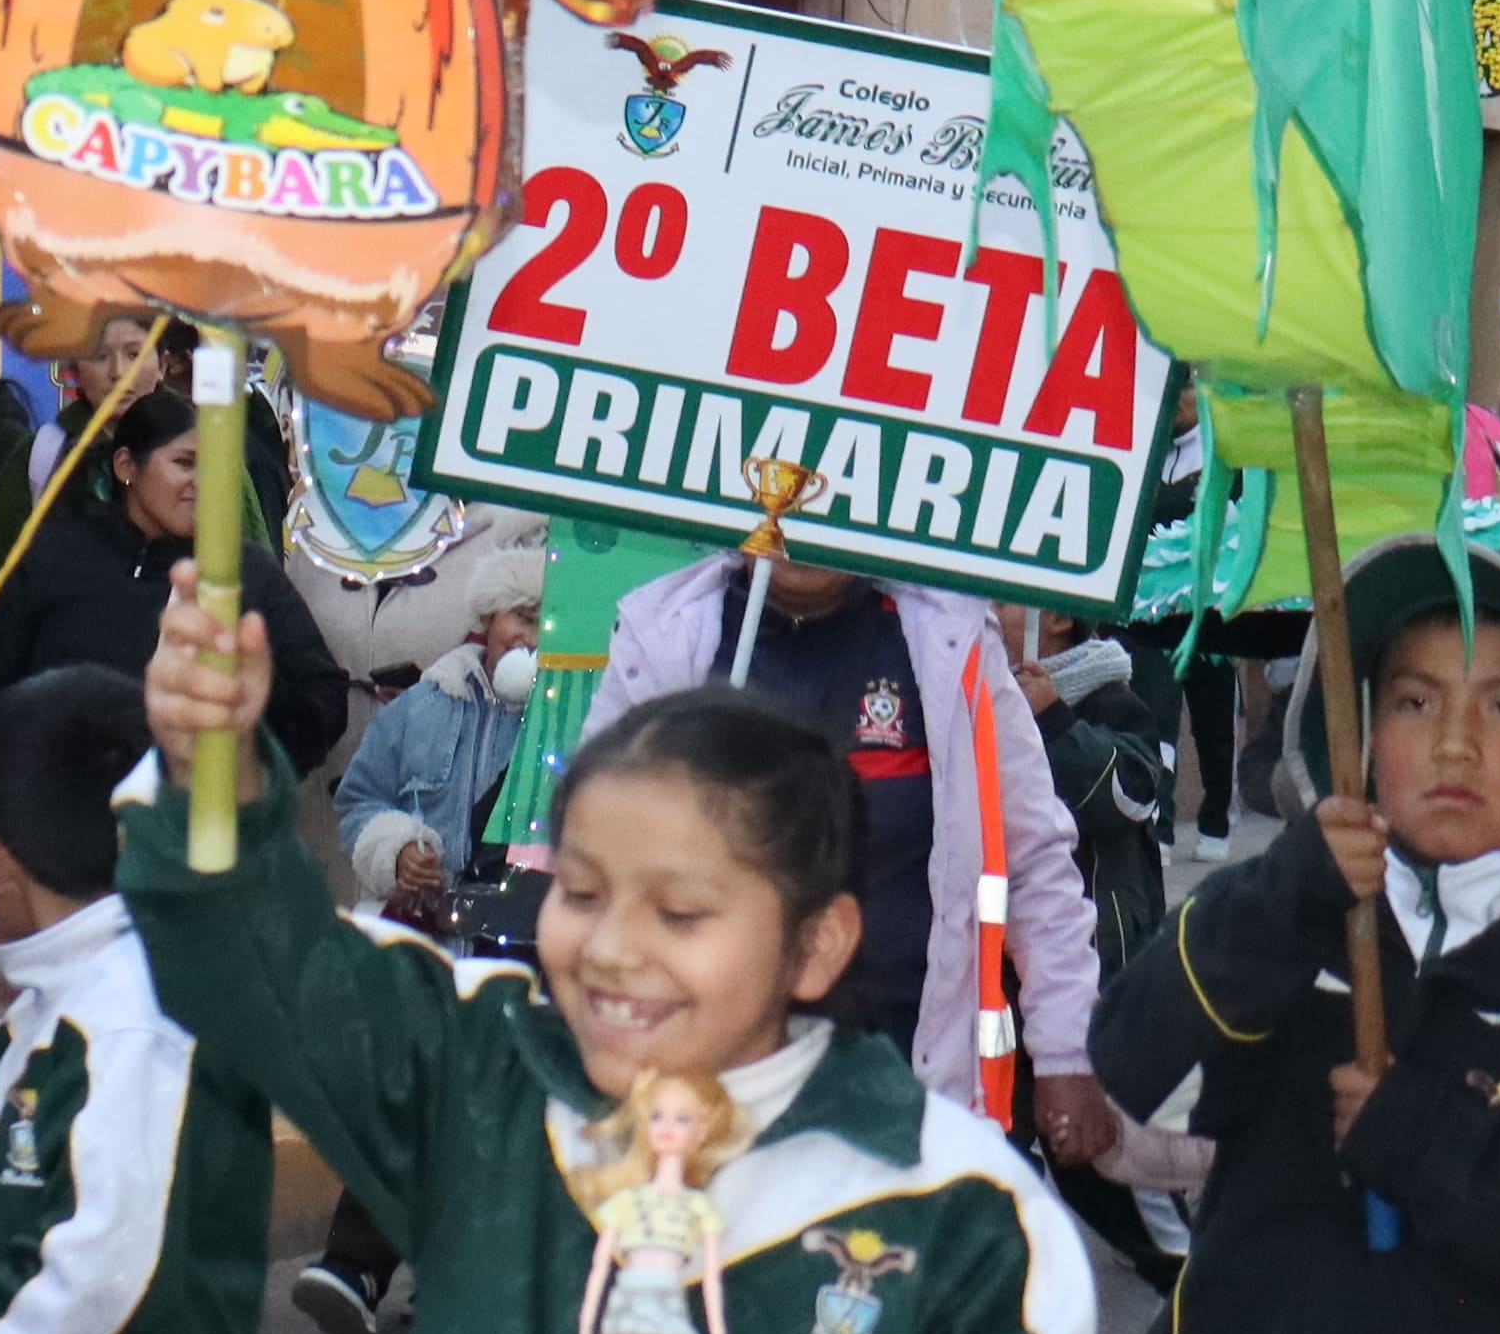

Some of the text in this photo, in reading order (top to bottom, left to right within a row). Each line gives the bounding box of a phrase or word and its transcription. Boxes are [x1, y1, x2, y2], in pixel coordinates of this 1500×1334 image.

[24, 97, 437, 217] CAPYBARA
[753, 84, 913, 156] James
[858, 161, 945, 195] Primaria
[952, 183, 964, 202] y
[725, 204, 1136, 452] BETA
[476, 353, 1094, 567] PRIMARIA
